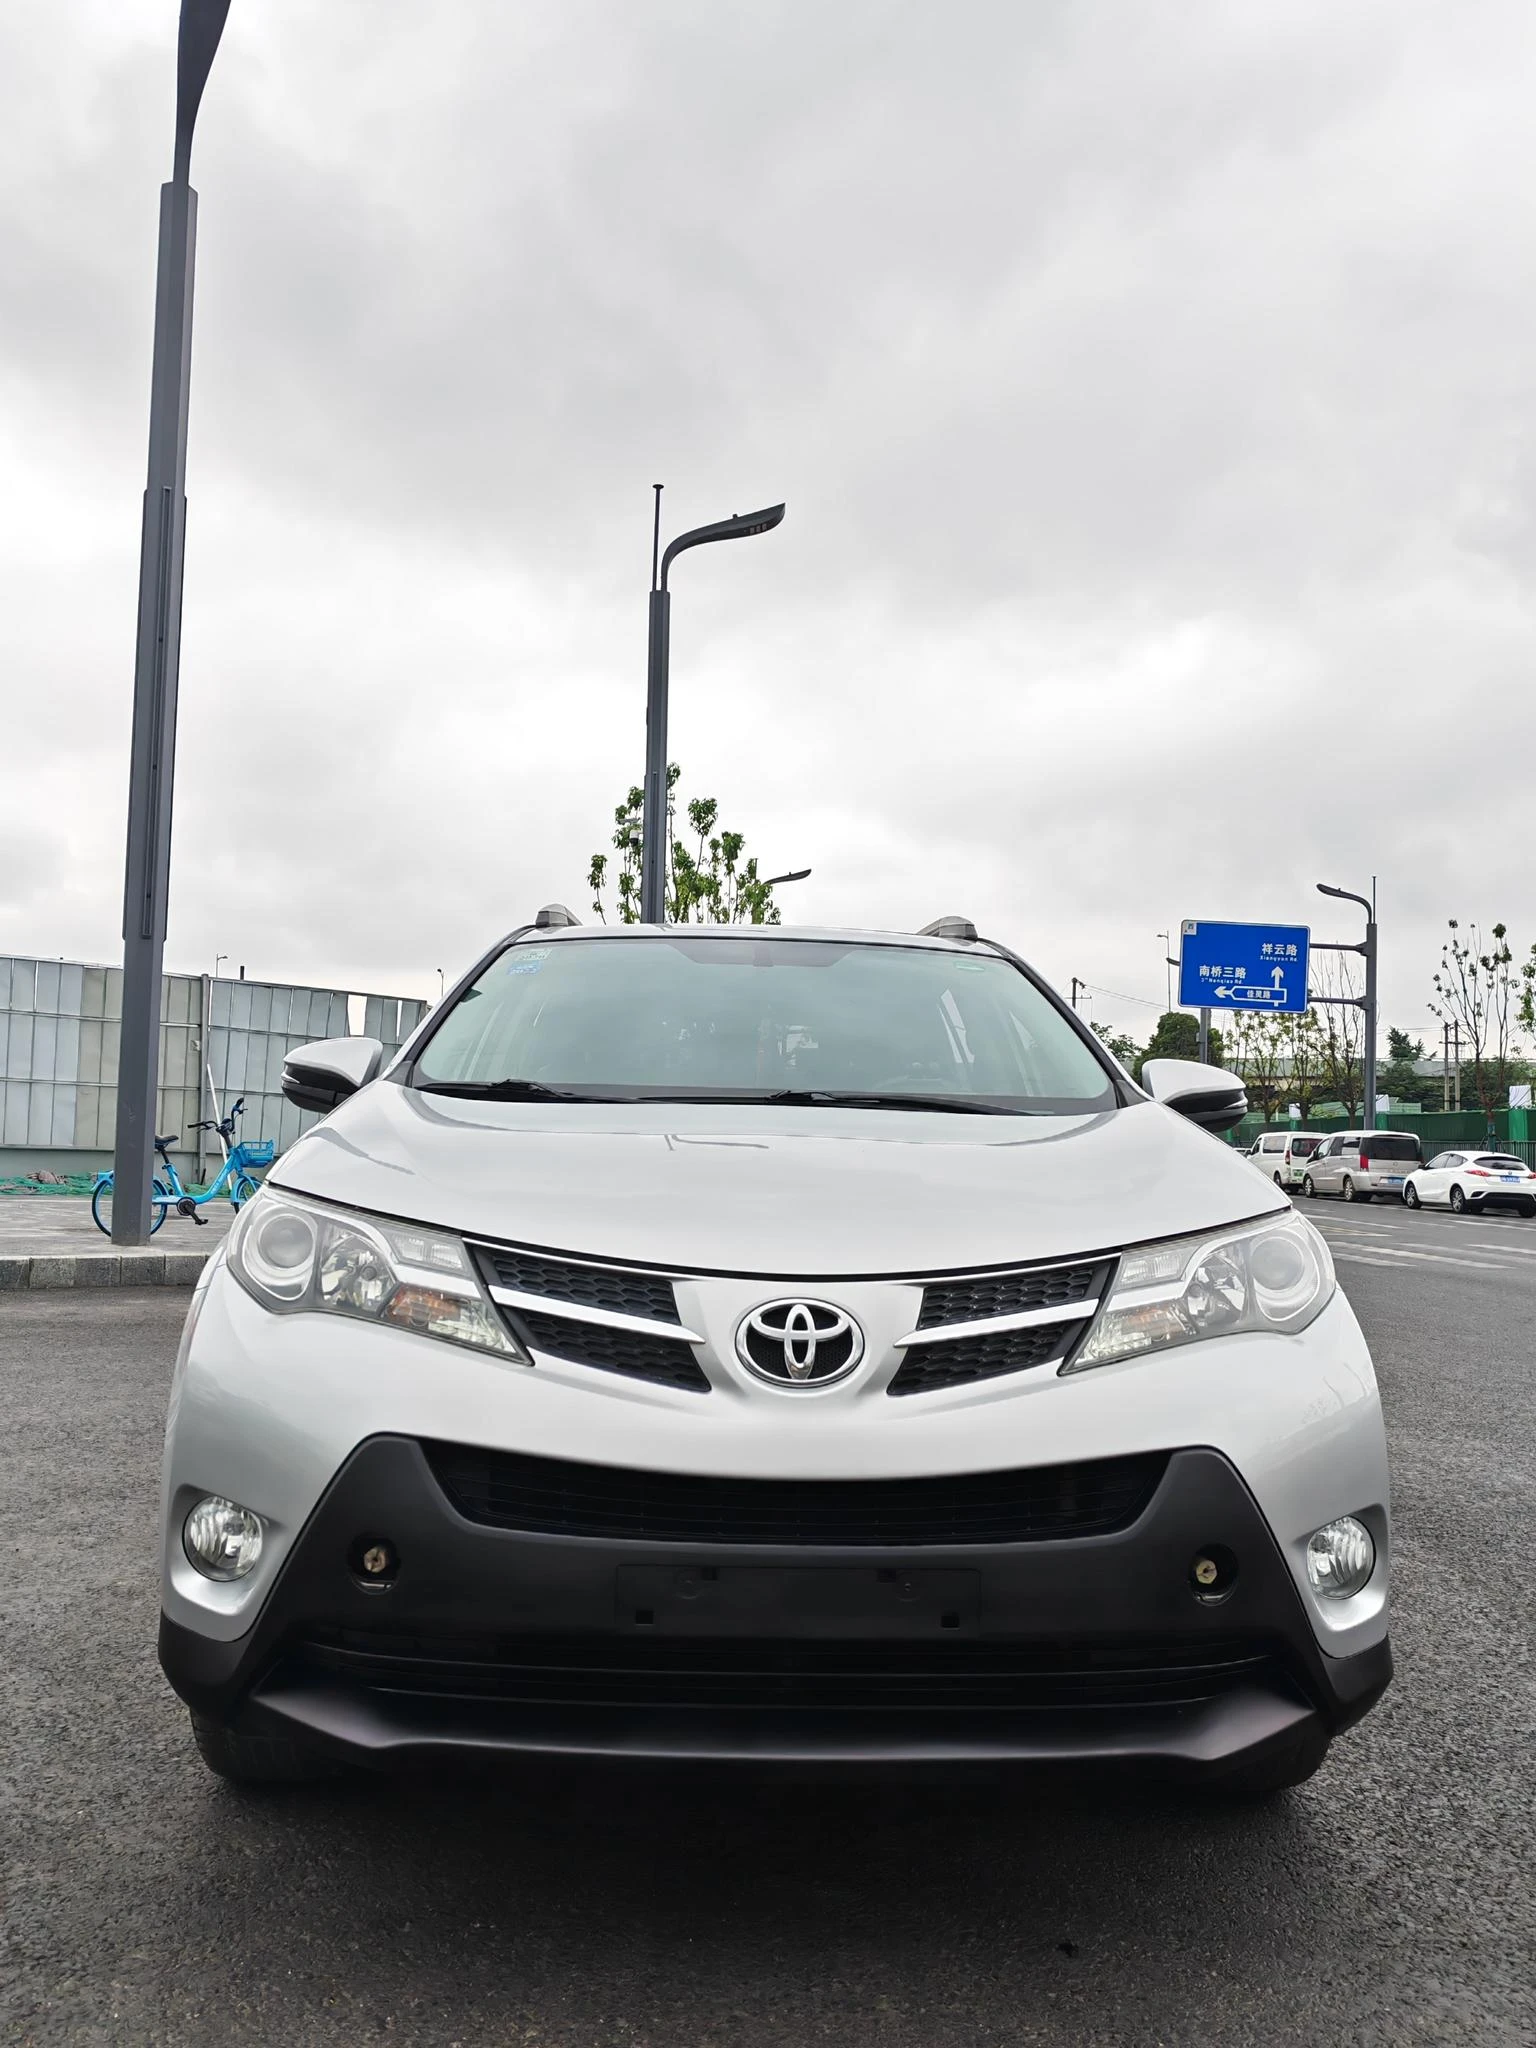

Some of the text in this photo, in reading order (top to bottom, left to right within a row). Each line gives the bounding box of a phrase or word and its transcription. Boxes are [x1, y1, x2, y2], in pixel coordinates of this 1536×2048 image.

[1261, 943, 1298, 956] 祥云路
[1199, 964, 1246, 979] 南桥三路
